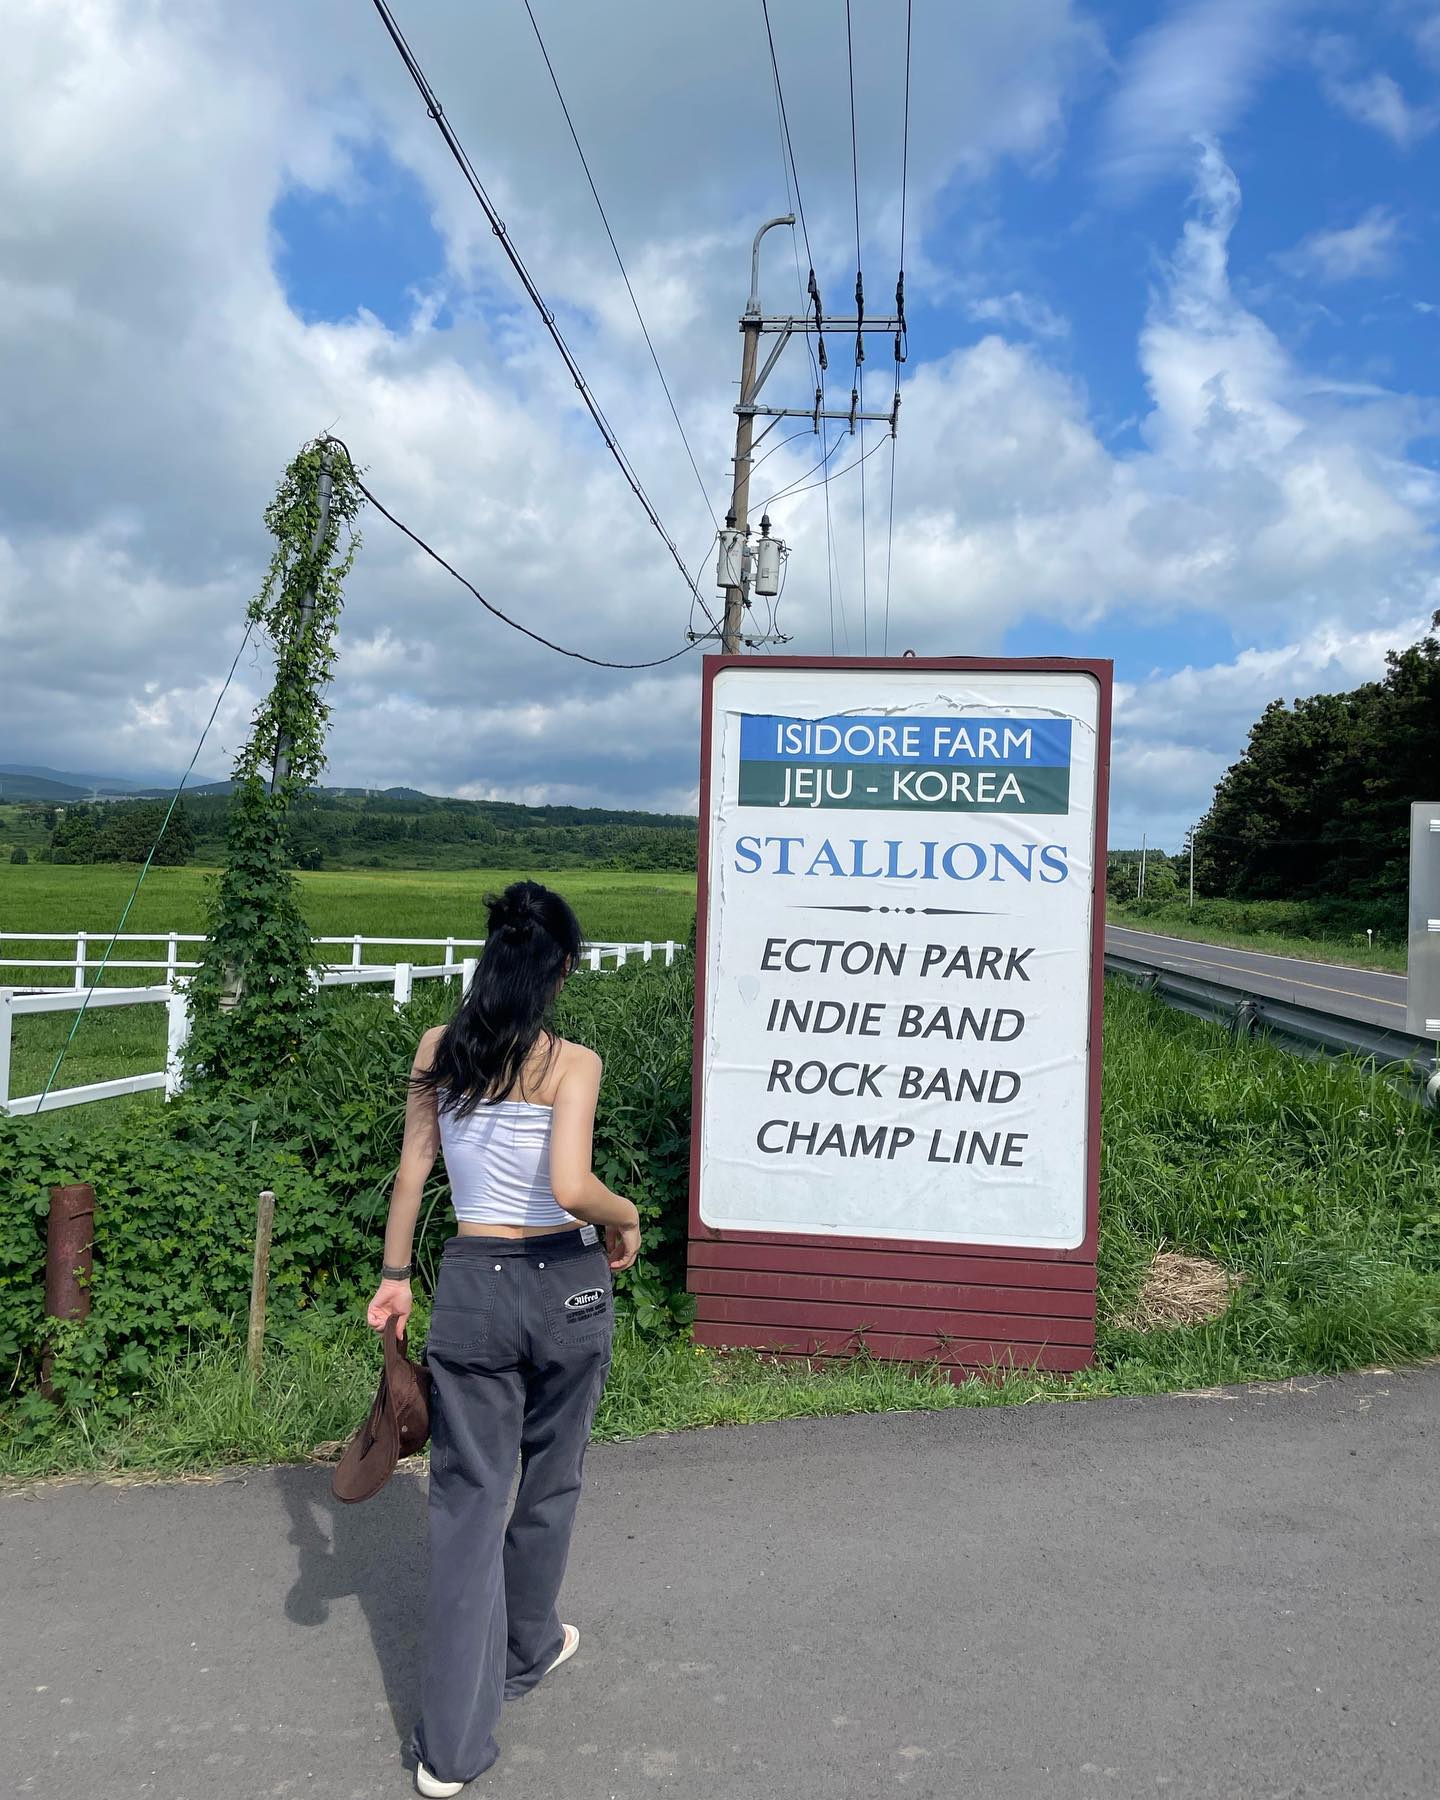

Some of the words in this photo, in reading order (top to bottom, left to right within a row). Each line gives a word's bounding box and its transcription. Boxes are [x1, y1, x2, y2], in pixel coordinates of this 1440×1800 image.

[776, 724, 920, 758] ISIDORE
[934, 726, 1032, 759] FARM
[779, 767, 854, 807] JEJU
[893, 771, 1025, 804] KOREA
[734, 835, 1069, 883] STALLIONS
[760, 938, 907, 976] ECTON
[919, 944, 1035, 981] PARK
[766, 998, 886, 1036] INDIE
[898, 1004, 1025, 1042] BAND
[767, 1059, 887, 1098] ROCK
[899, 1065, 1022, 1104] BAND
[756, 1119, 915, 1160] CHAMP
[928, 1128, 1029, 1167] LINE
[574, 1291, 599, 1306] Alfred
